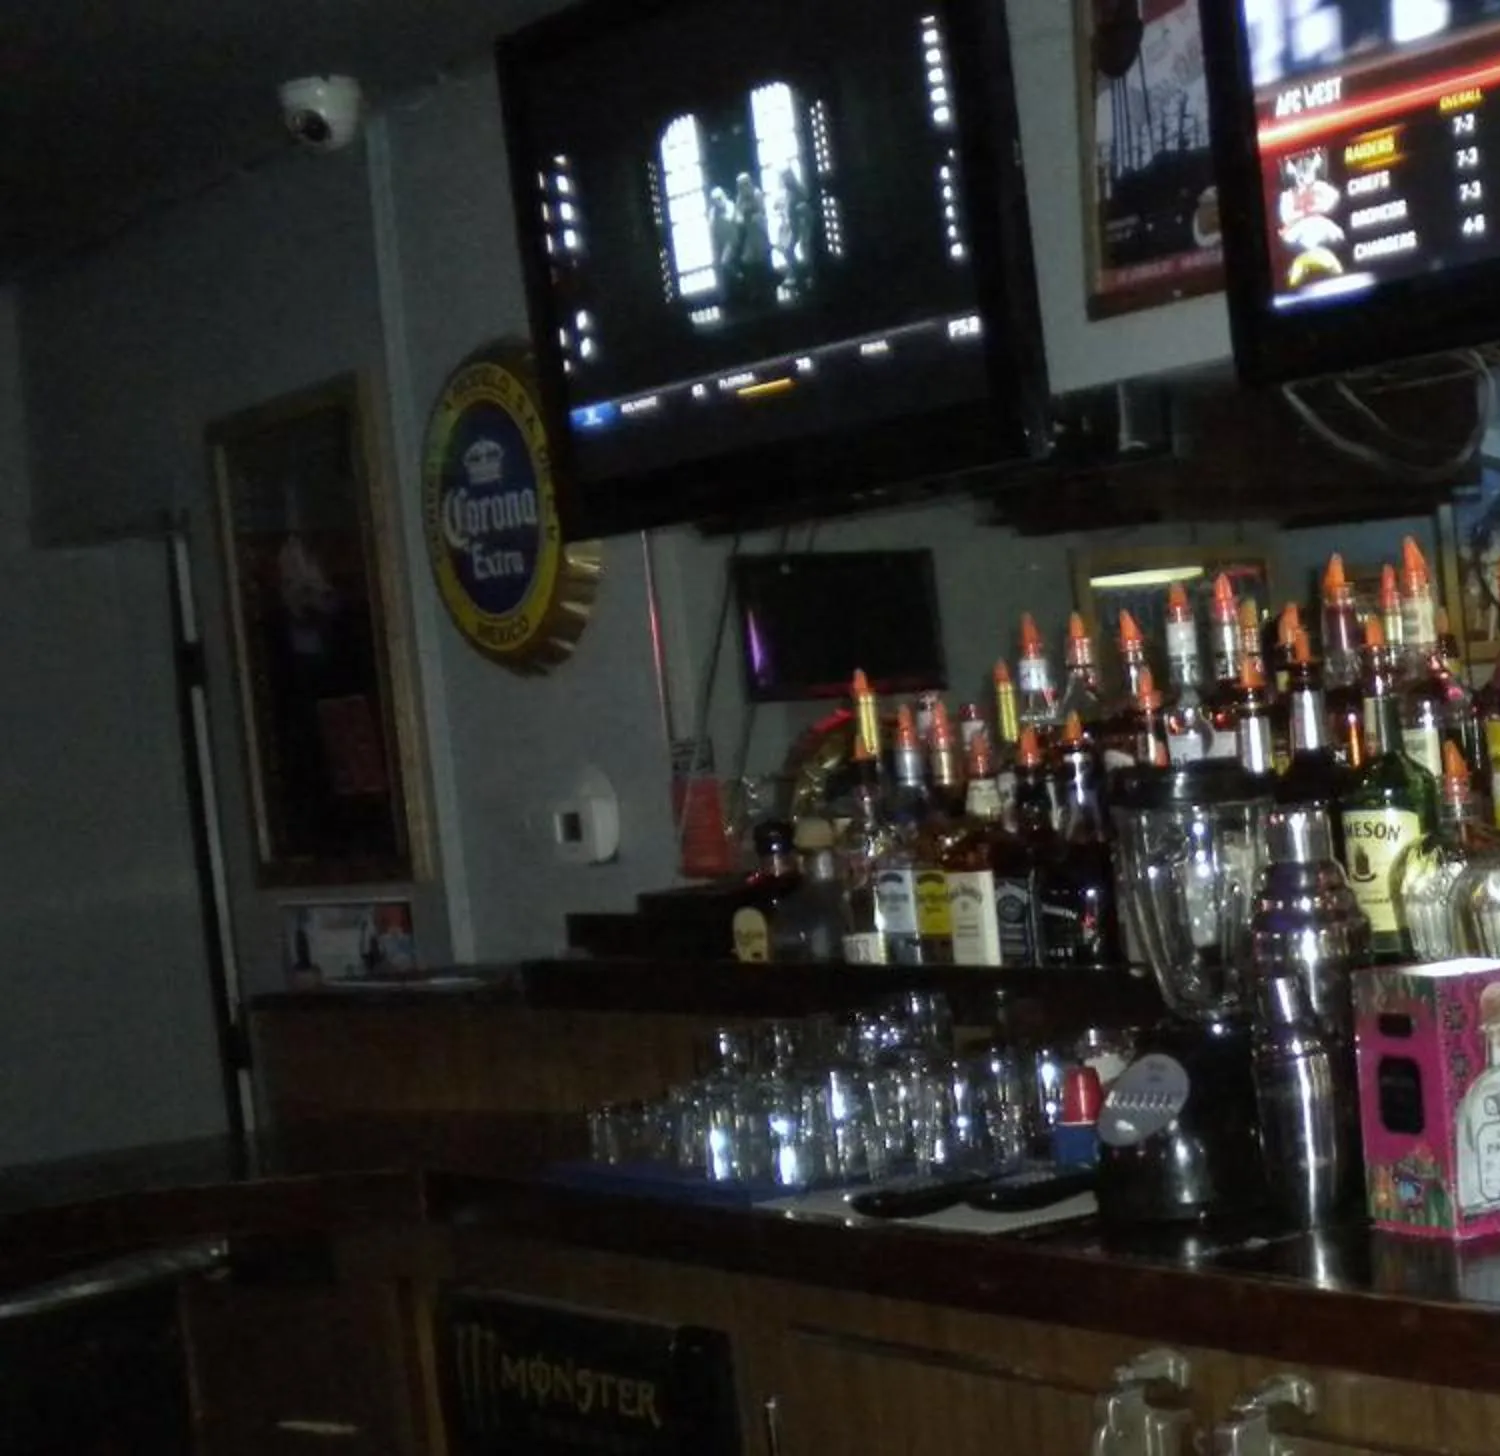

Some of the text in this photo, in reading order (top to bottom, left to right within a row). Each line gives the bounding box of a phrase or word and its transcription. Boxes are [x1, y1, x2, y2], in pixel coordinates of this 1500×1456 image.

[1275, 77, 1342, 117] AFC WEST
[1344, 137, 1396, 164] RAIDERS
[1347, 170, 1390, 196] CHIEFS
[1351, 200, 1408, 228] BRONCOS
[1354, 231, 1417, 262] CHARGERS
[445, 486, 538, 549] Corona
[472, 540, 525, 580] Extra
[501, 1350, 663, 1430] MONSTER
